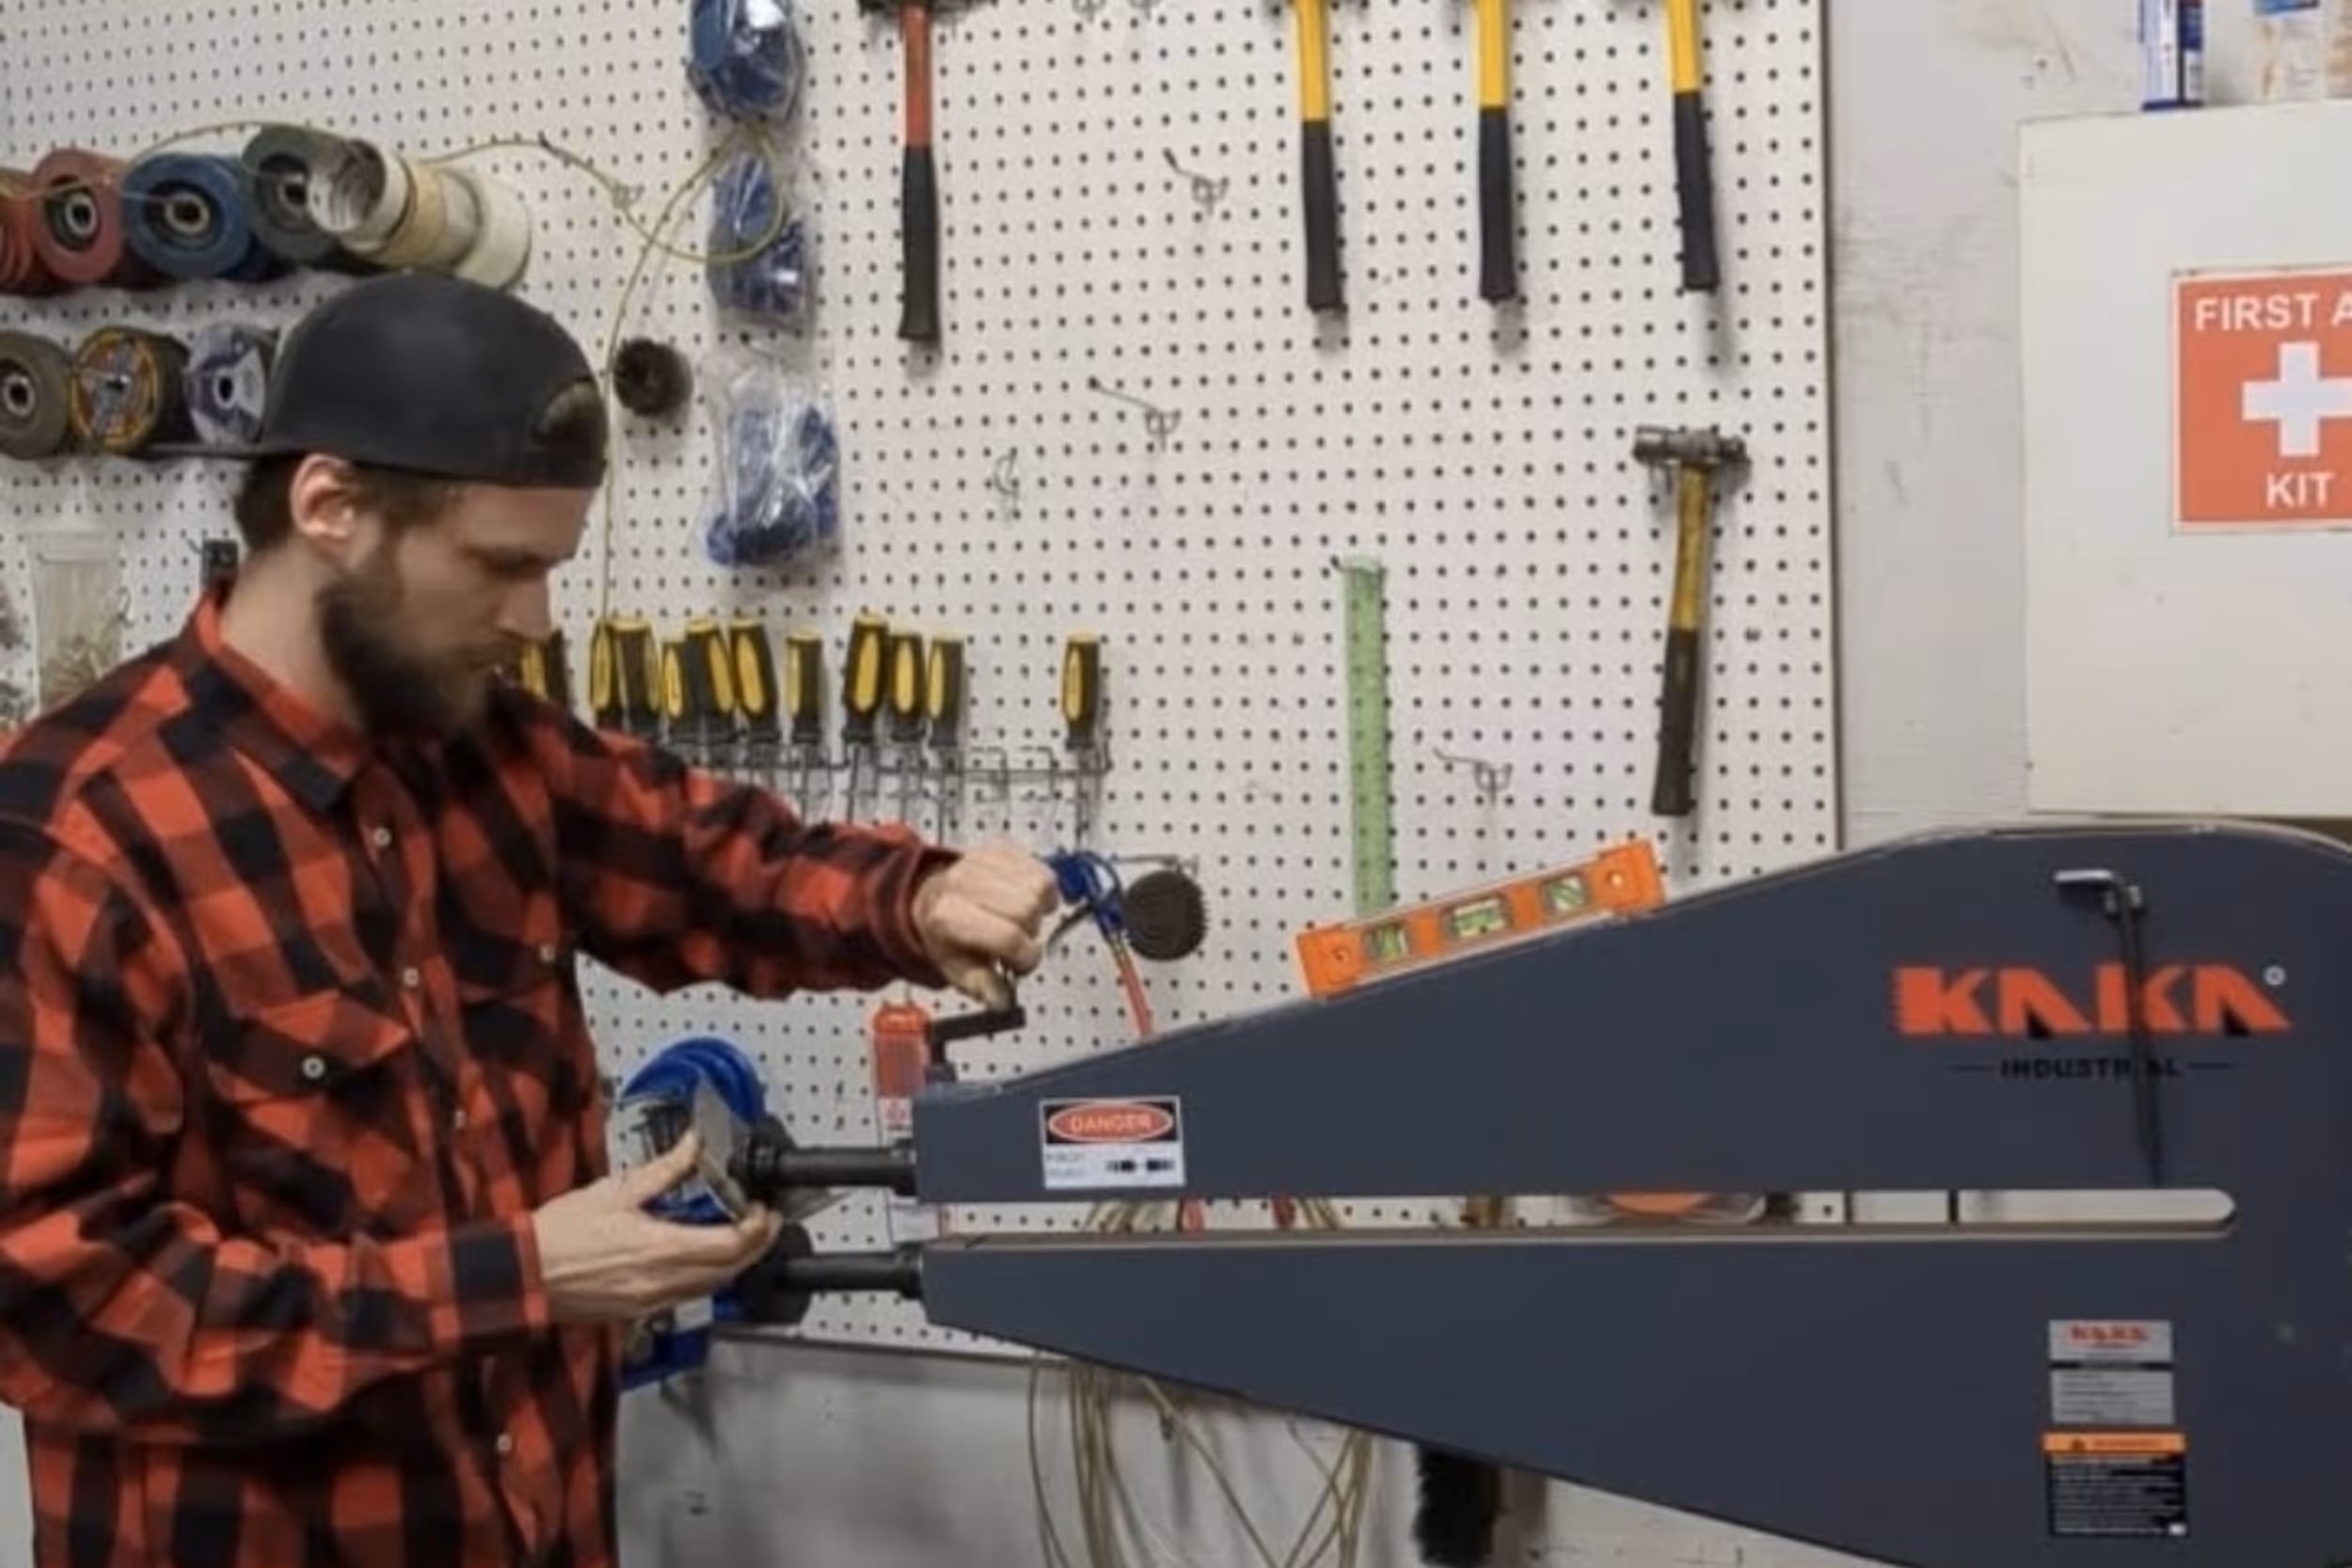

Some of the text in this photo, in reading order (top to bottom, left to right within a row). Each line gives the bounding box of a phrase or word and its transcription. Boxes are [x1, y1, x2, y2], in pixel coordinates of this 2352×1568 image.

[2195, 293, 2320, 331] FIRST
[2267, 472, 2334, 508] KIT
[2000, 1057, 2184, 1079] INDUSTRAL
